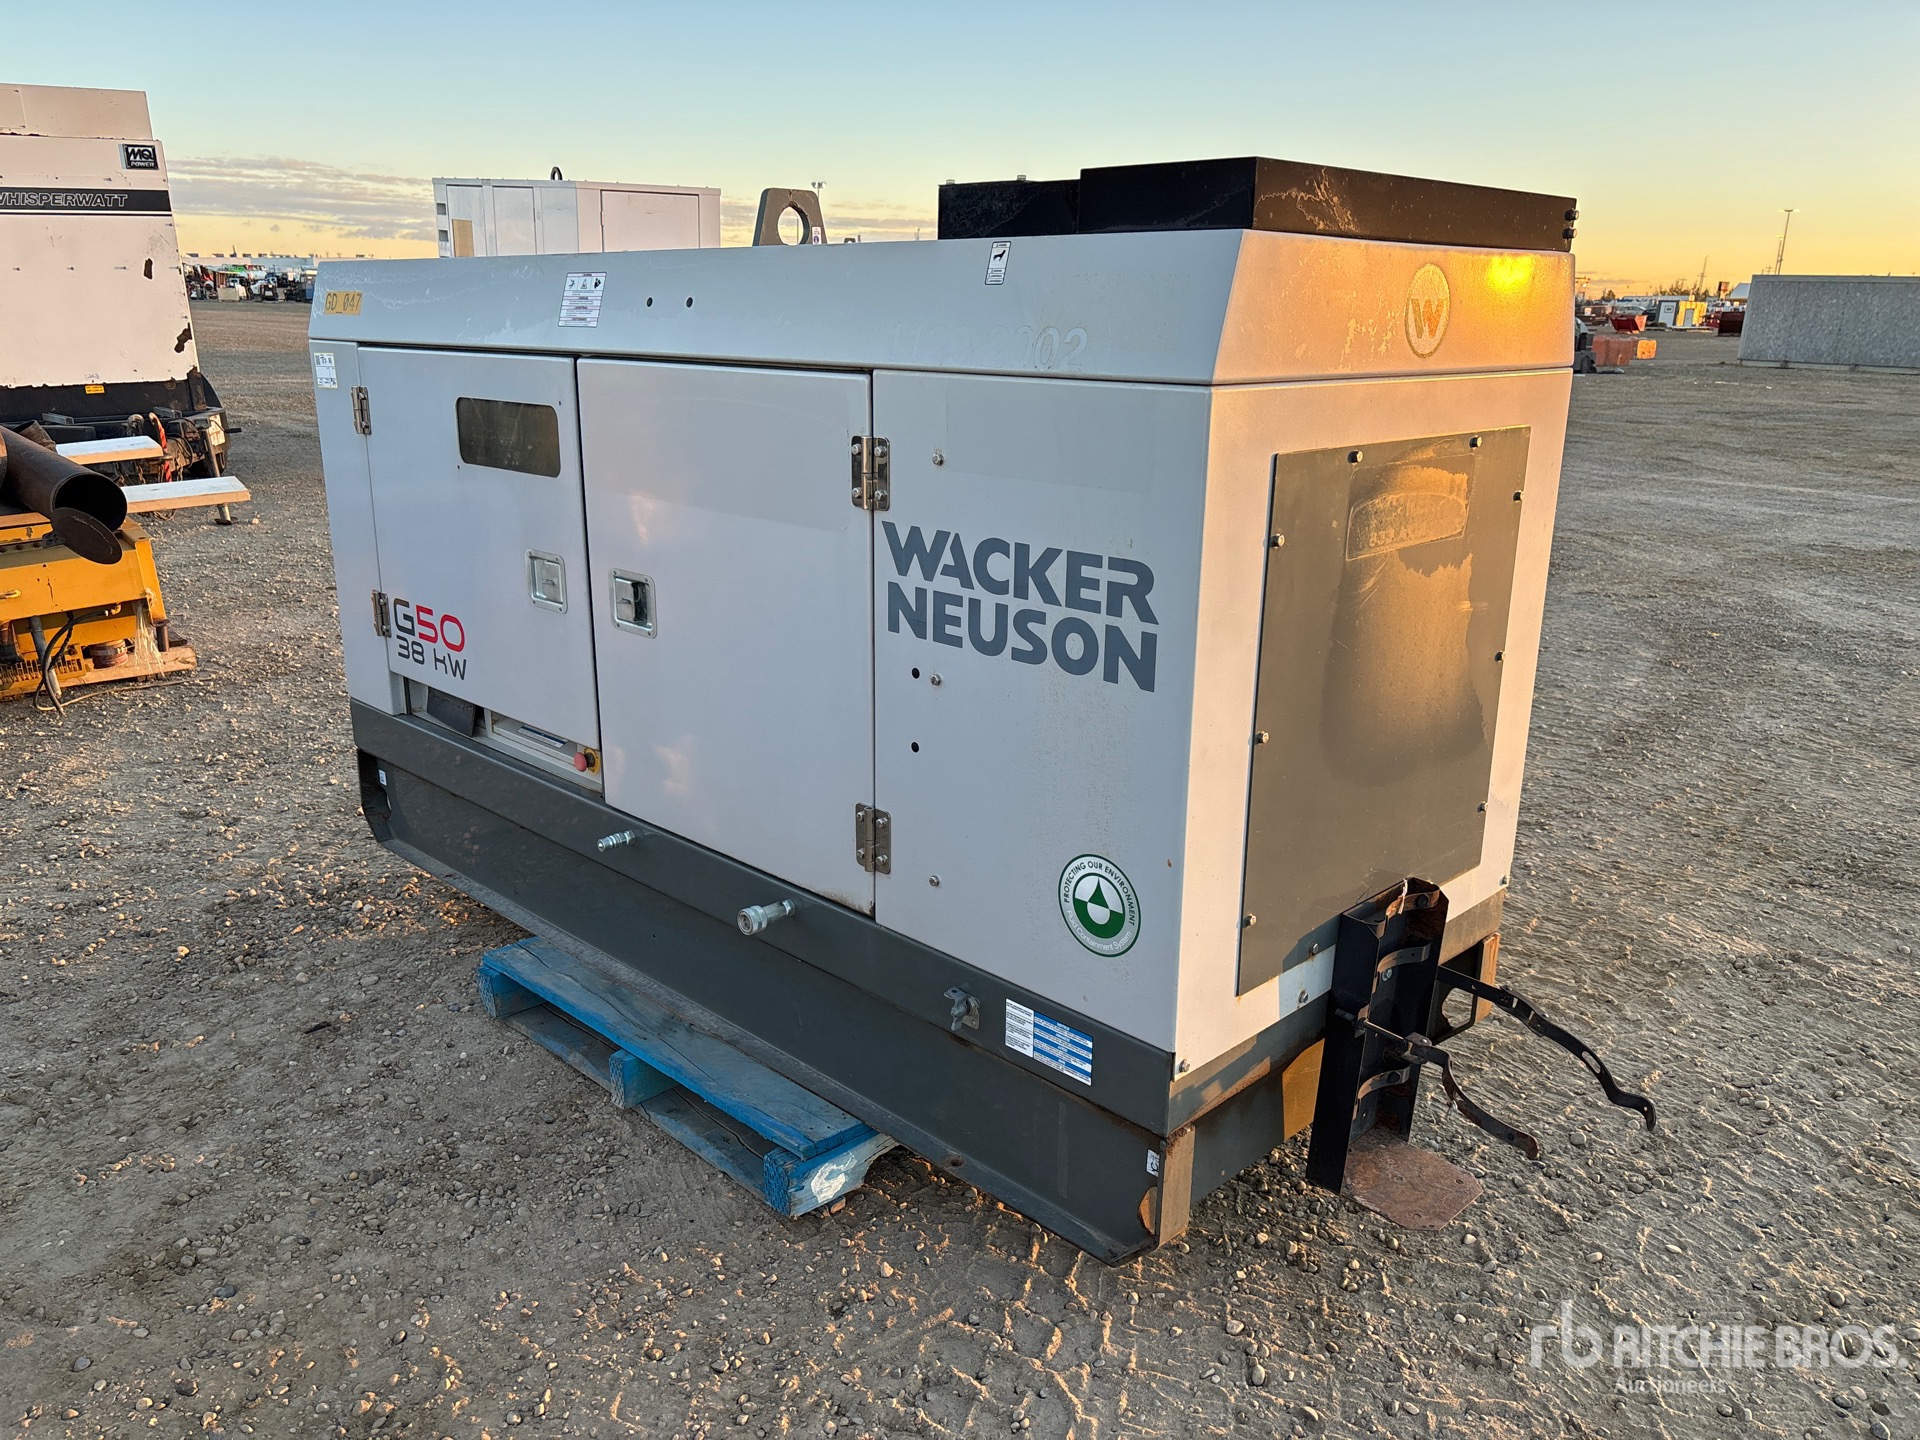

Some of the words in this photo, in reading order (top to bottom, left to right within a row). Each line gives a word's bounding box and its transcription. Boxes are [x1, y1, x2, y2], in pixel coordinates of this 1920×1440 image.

[127, 147, 155, 161] MQ
[881, 520, 1159, 625] WACKER
[393, 598, 465, 652] G50
[396, 635, 425, 665] 38
[887, 580, 1158, 693] NEUSON
[1063, 861, 1087, 904] PROTECTING
[1087, 860, 1103, 871] OUR
[1104, 865, 1136, 926] ENVIRONMENT
[1066, 909, 1078, 929] Fluid
[1076, 926, 1114, 951] Containment
[1113, 930, 1132, 950] System
